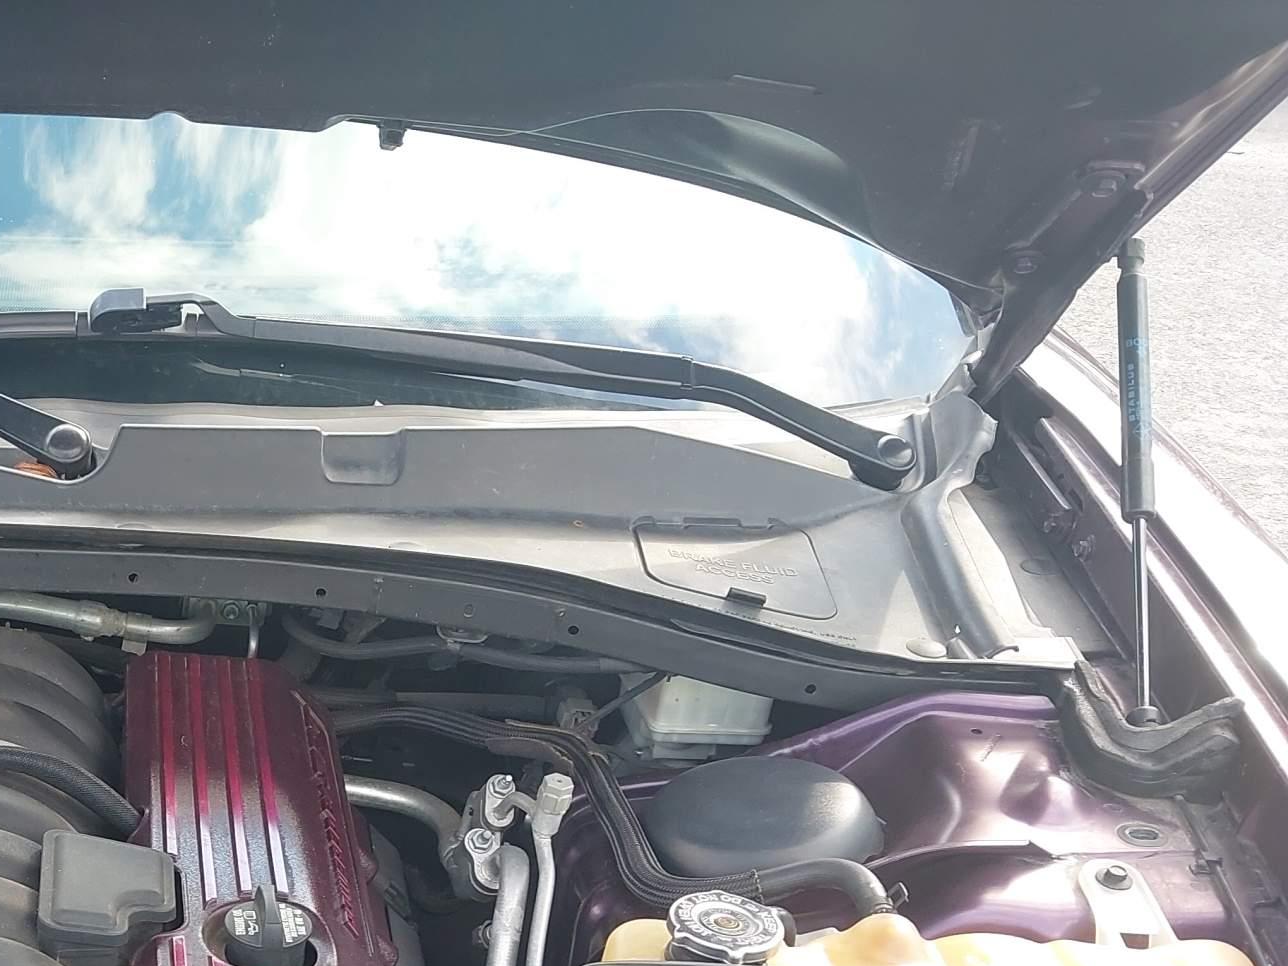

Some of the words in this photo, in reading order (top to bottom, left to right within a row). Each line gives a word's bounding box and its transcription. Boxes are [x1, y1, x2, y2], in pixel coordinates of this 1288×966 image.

[668, 549, 737, 569] BRAKE
[741, 562, 799, 577] FLUID
[695, 563, 775, 585] ACCESS
[719, 894, 743, 904] DO
